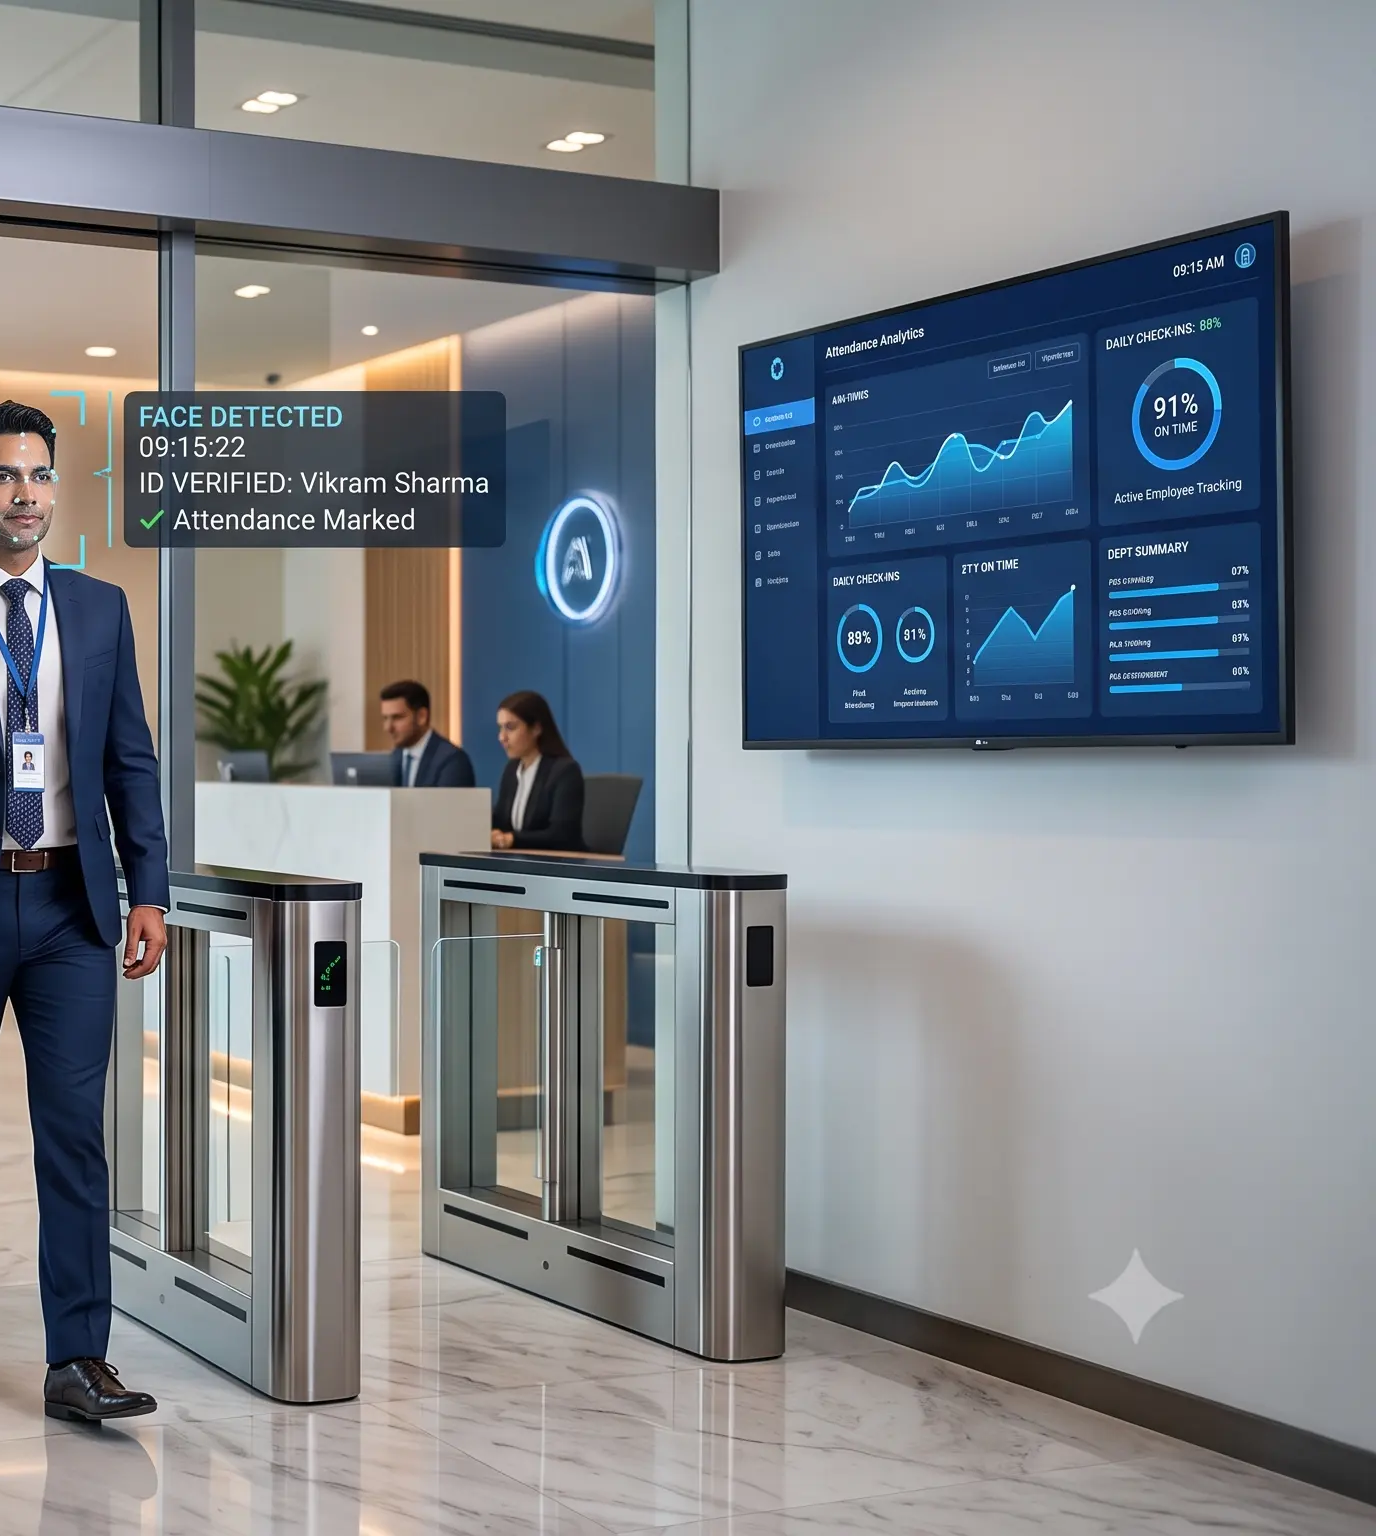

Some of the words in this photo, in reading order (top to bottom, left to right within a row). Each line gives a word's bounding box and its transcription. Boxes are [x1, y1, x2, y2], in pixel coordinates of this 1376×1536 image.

[1173, 259, 1204, 278] 09:15
[1205, 254, 1224, 271] AM
[825, 338, 878, 359] Attendance
[880, 328, 924, 345] Analytics
[1105, 334, 1135, 350] DAILY
[1136, 322, 1196, 344] CHECK-INS:
[1199, 316, 1222, 331] 88%
[1153, 392, 1199, 420] 91%
[1154, 425, 1170, 437] ON
[1172, 421, 1198, 435] TIME
[1114, 492, 1144, 504] Active
[1145, 485, 1195, 501] Employee
[1196, 479, 1242, 492] Tracking
[1107, 547, 1133, 560] DEPT
[1135, 541, 1189, 557] SUMMARY
[981, 561, 994, 572] ON
[995, 558, 1019, 570] TIME
